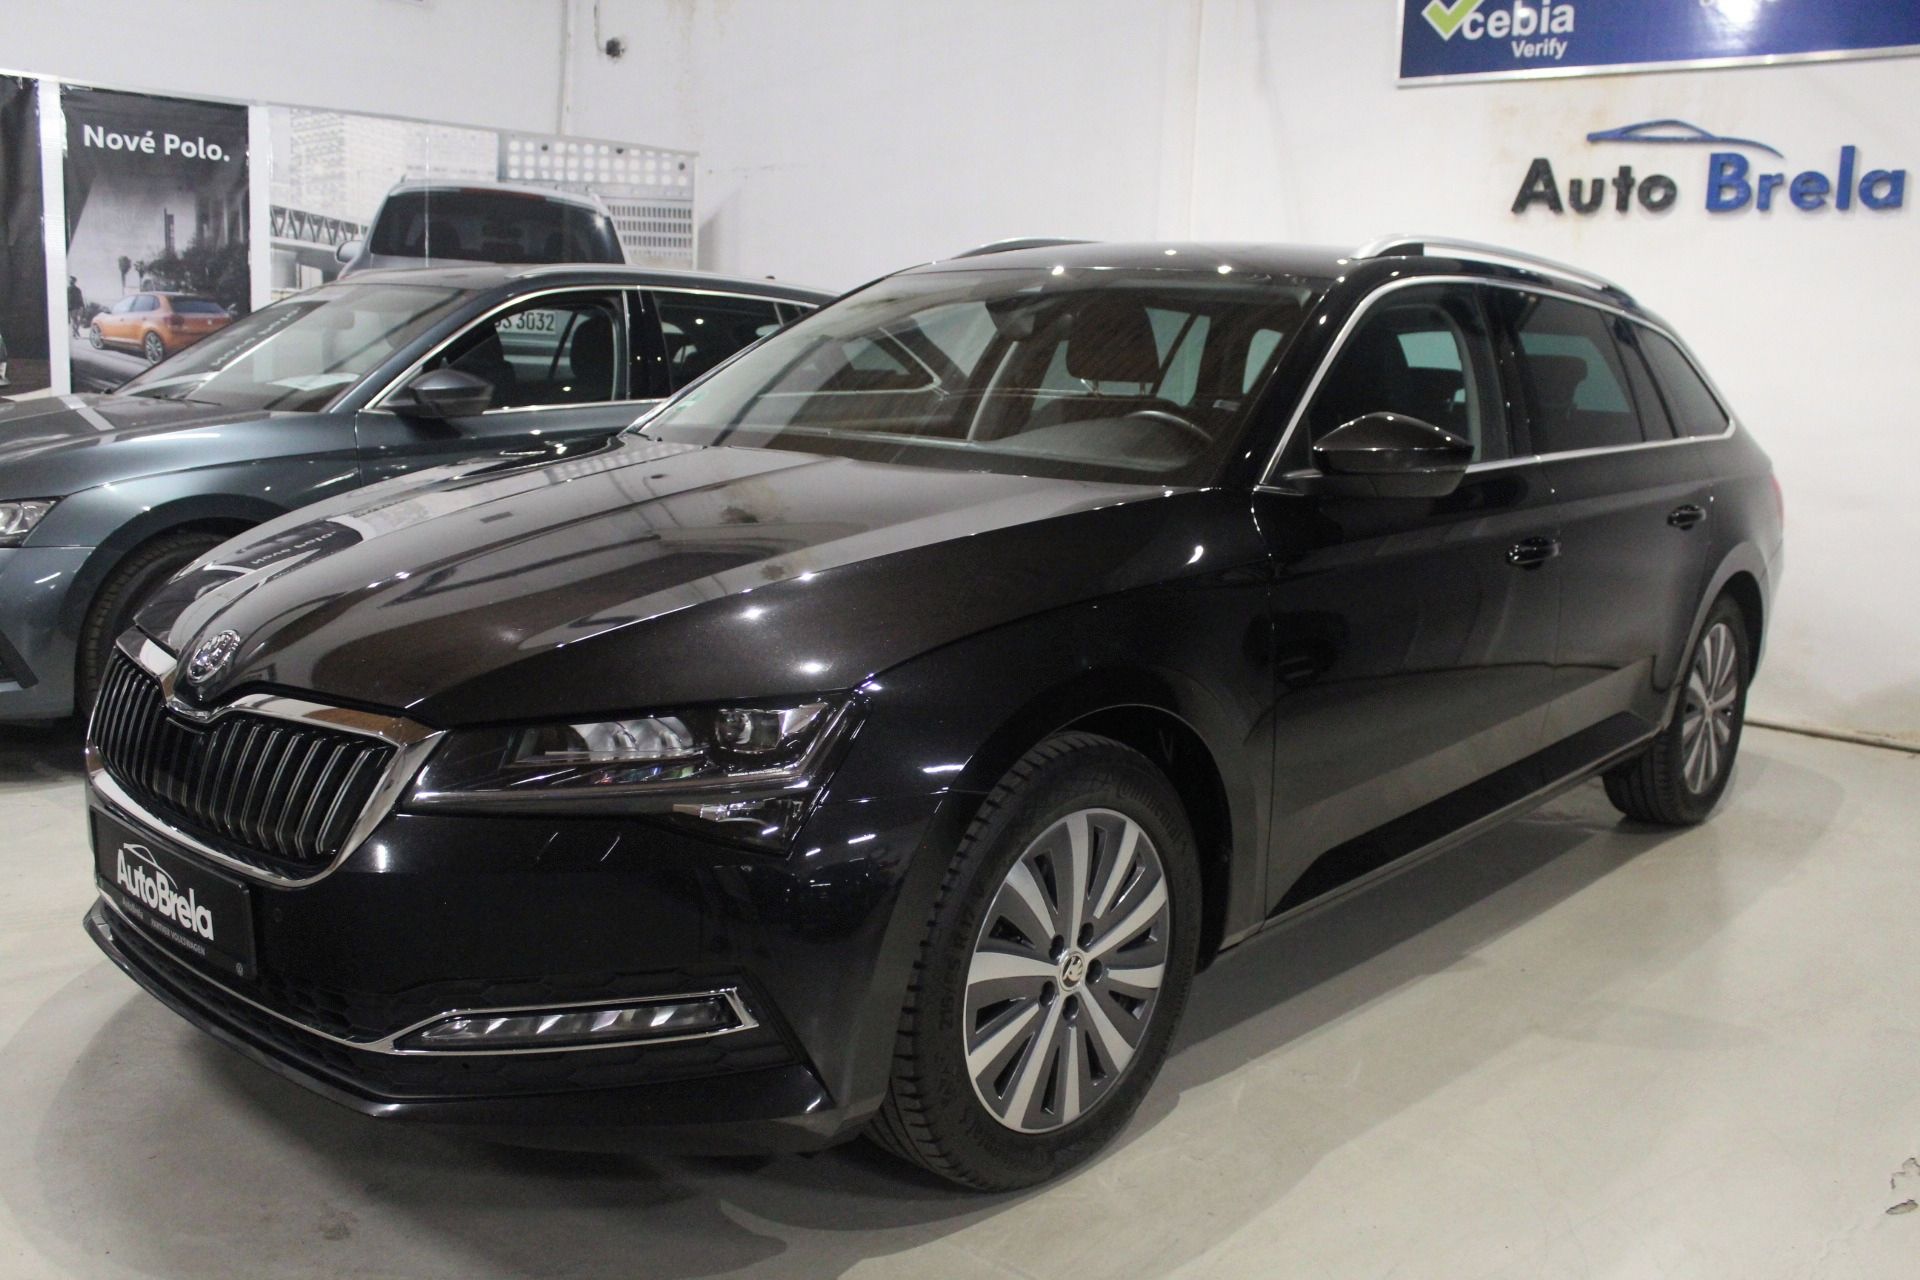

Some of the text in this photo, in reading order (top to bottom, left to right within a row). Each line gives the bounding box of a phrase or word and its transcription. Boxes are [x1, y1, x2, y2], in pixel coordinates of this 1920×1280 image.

[1462, 0, 1574, 40] cebia
[1511, 38, 1568, 60] Verify
[83, 125, 230, 161] Nové Polo.
[1511, 145, 1907, 215] Auto Brela
[516, 312, 554, 331] 3032
[117, 849, 214, 941] AutoBrela
